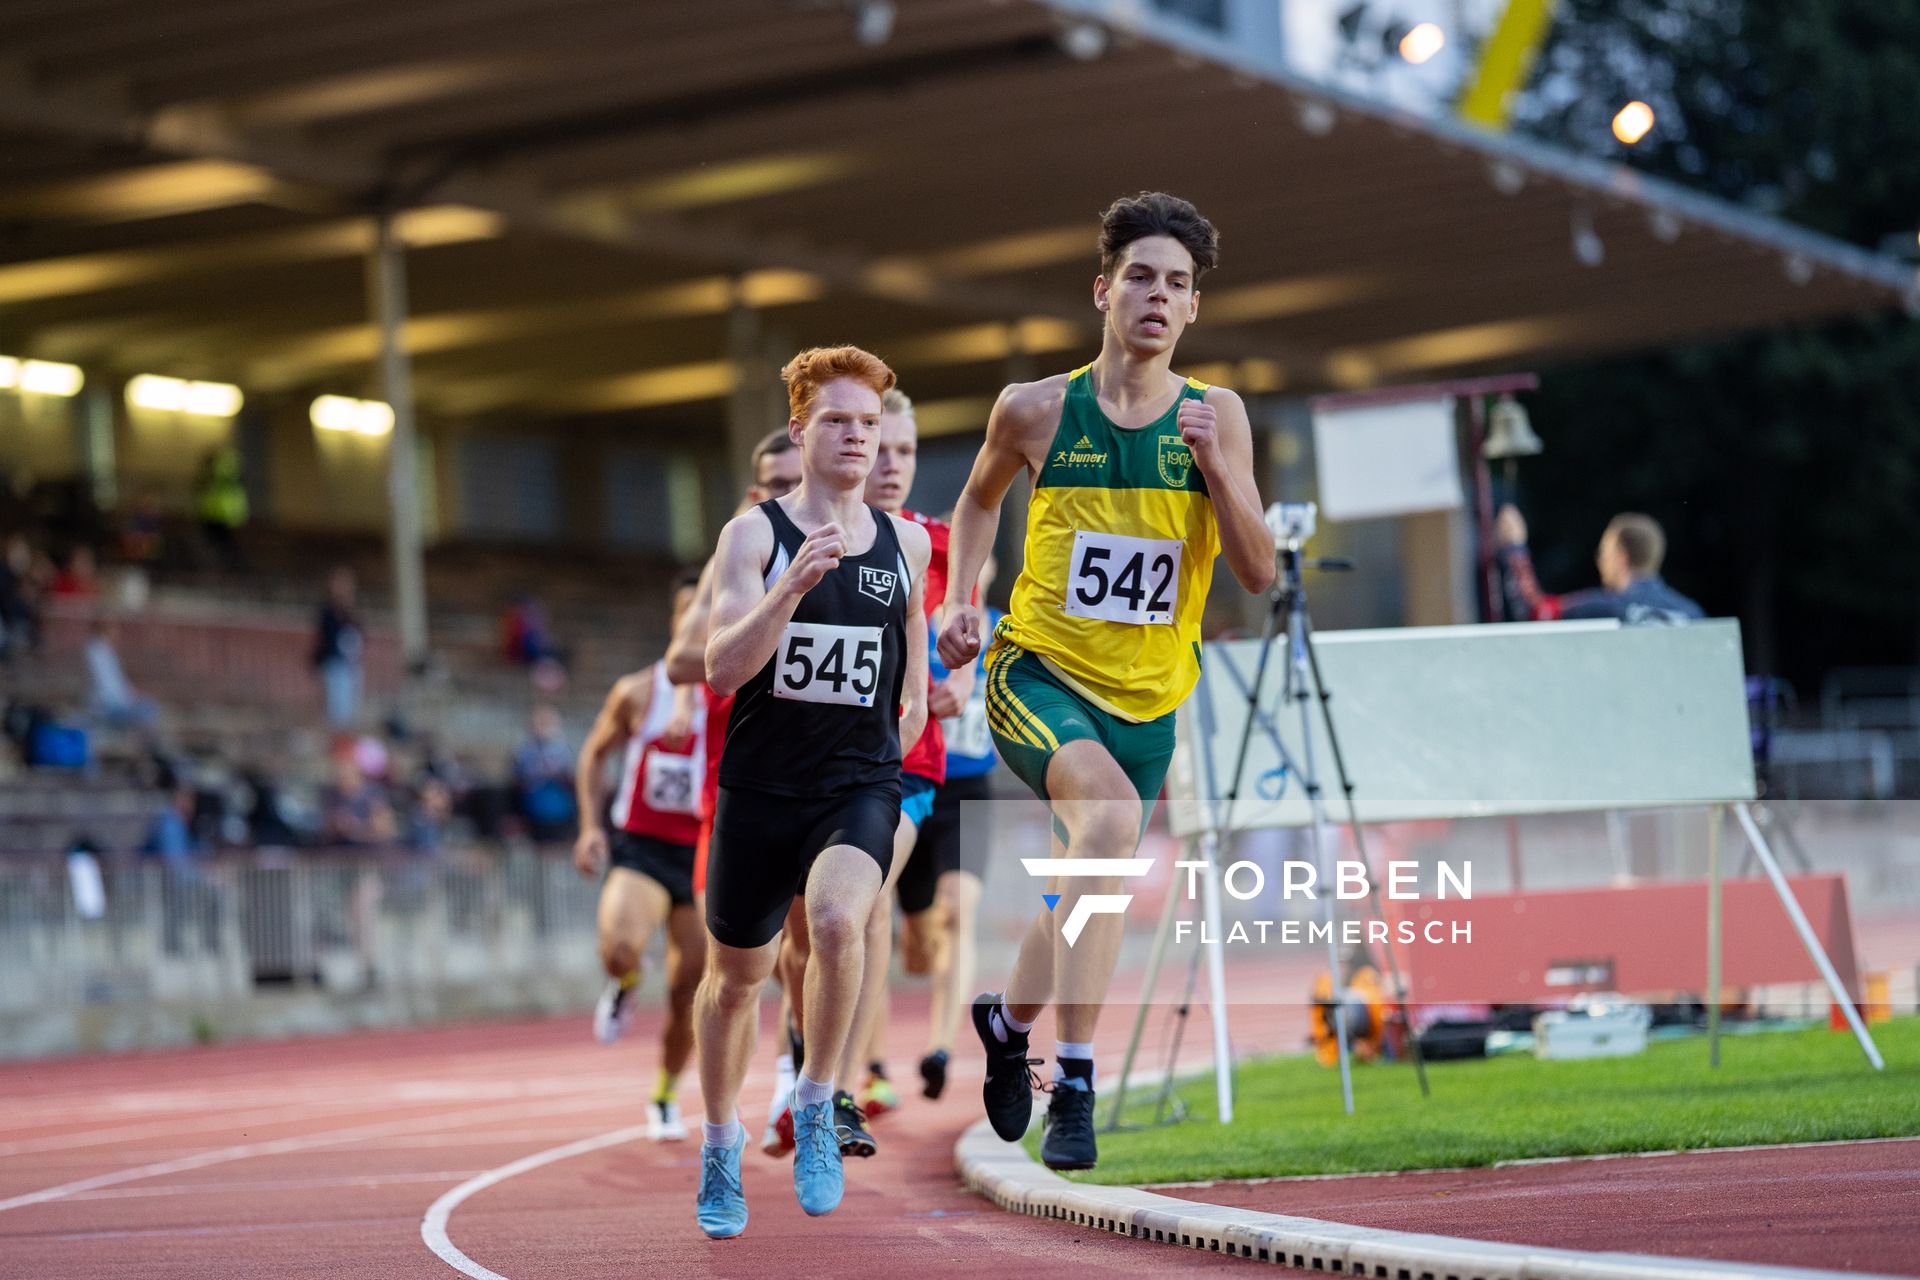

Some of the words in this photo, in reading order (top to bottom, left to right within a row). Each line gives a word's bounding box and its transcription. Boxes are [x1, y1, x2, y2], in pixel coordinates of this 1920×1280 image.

[1068, 451, 1108, 463] bunert
[862, 570, 893, 587] TLG
[1075, 546, 1174, 612] 542
[782, 636, 878, 695] 545
